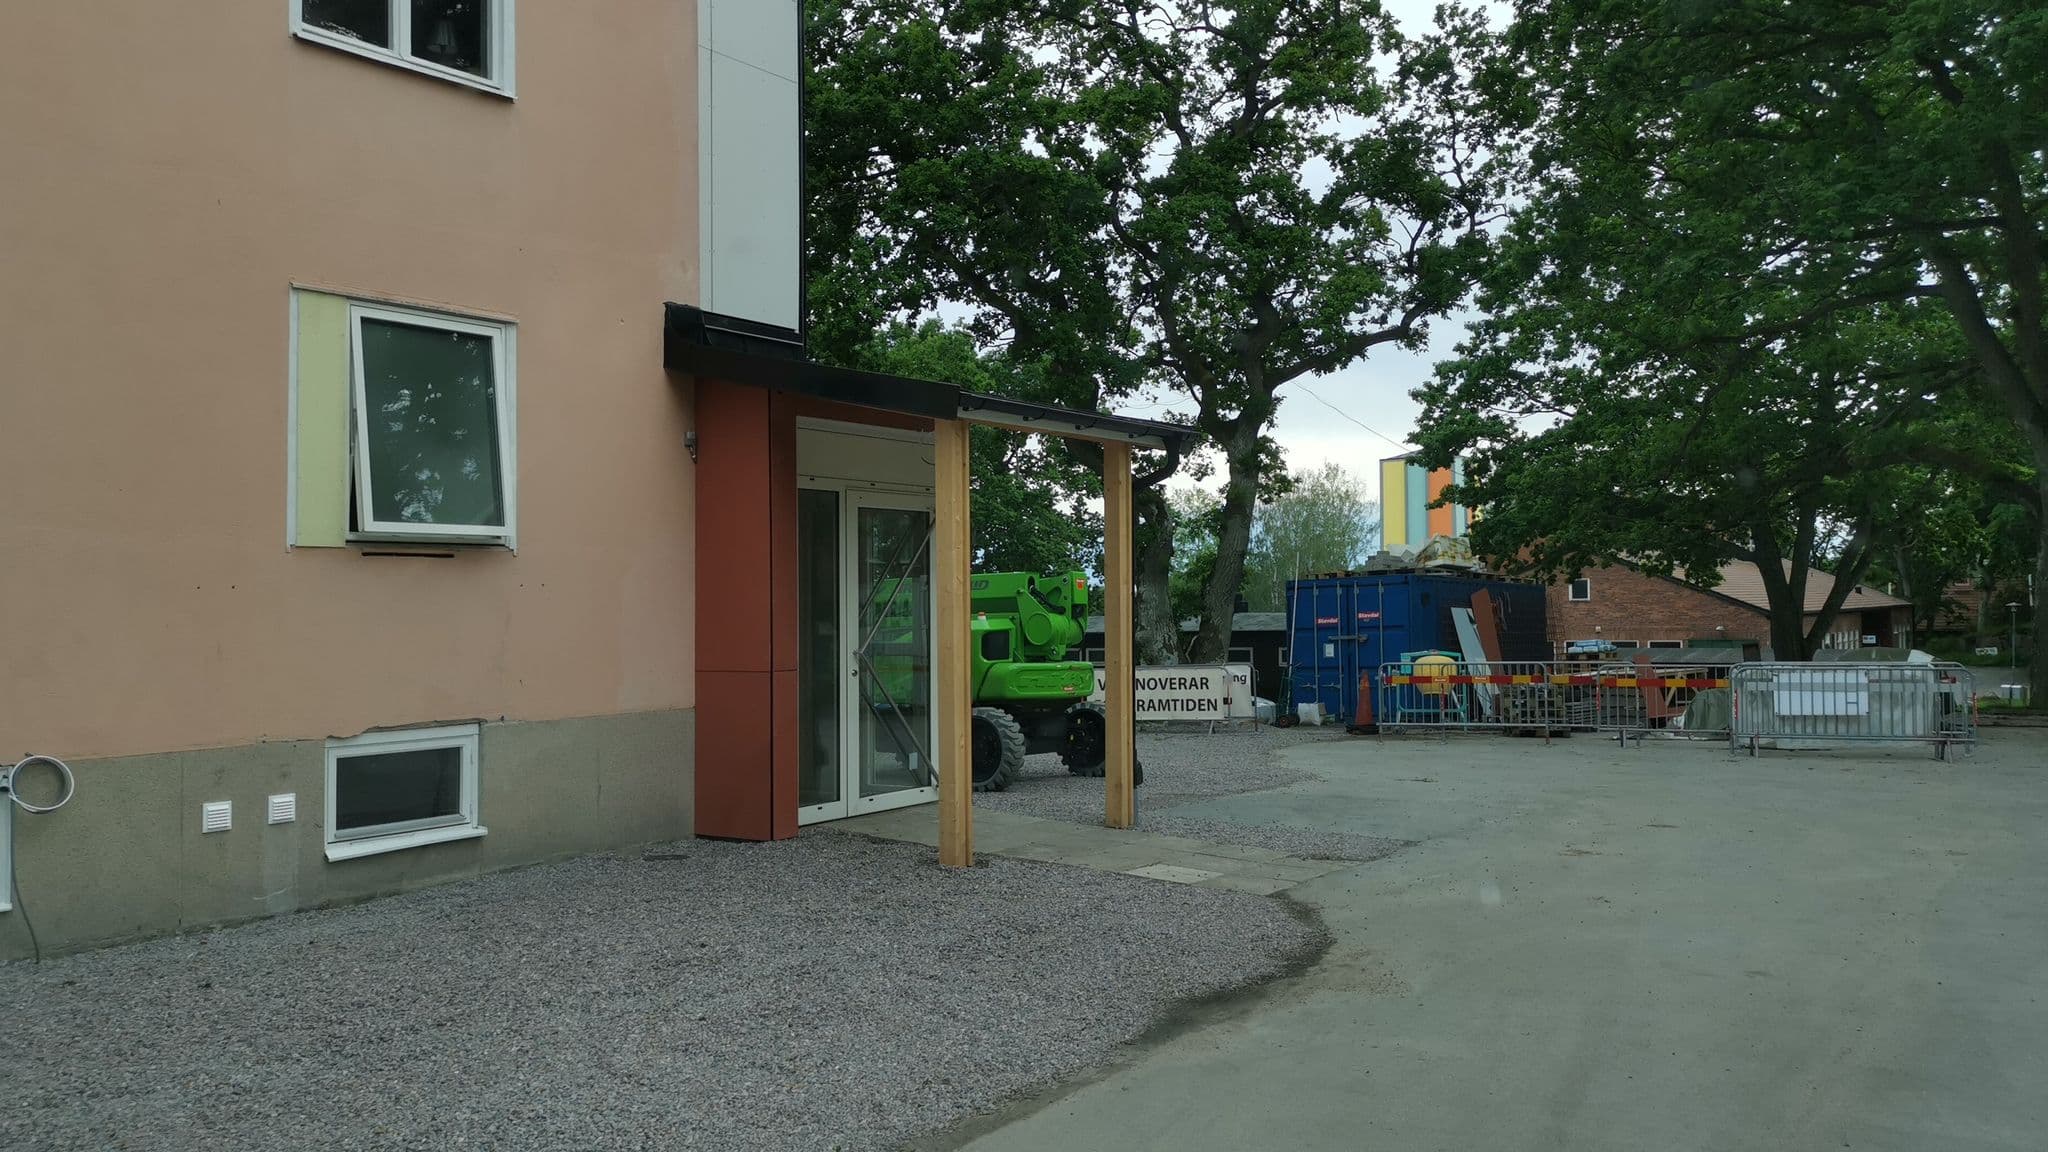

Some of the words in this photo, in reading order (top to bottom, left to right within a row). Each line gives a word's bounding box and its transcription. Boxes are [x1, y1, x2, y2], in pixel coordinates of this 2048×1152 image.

[1135, 677, 1210, 691] NOVERAR
[1233, 674, 1247, 684] ng
[1136, 698, 1219, 712] RAMTIDEN
